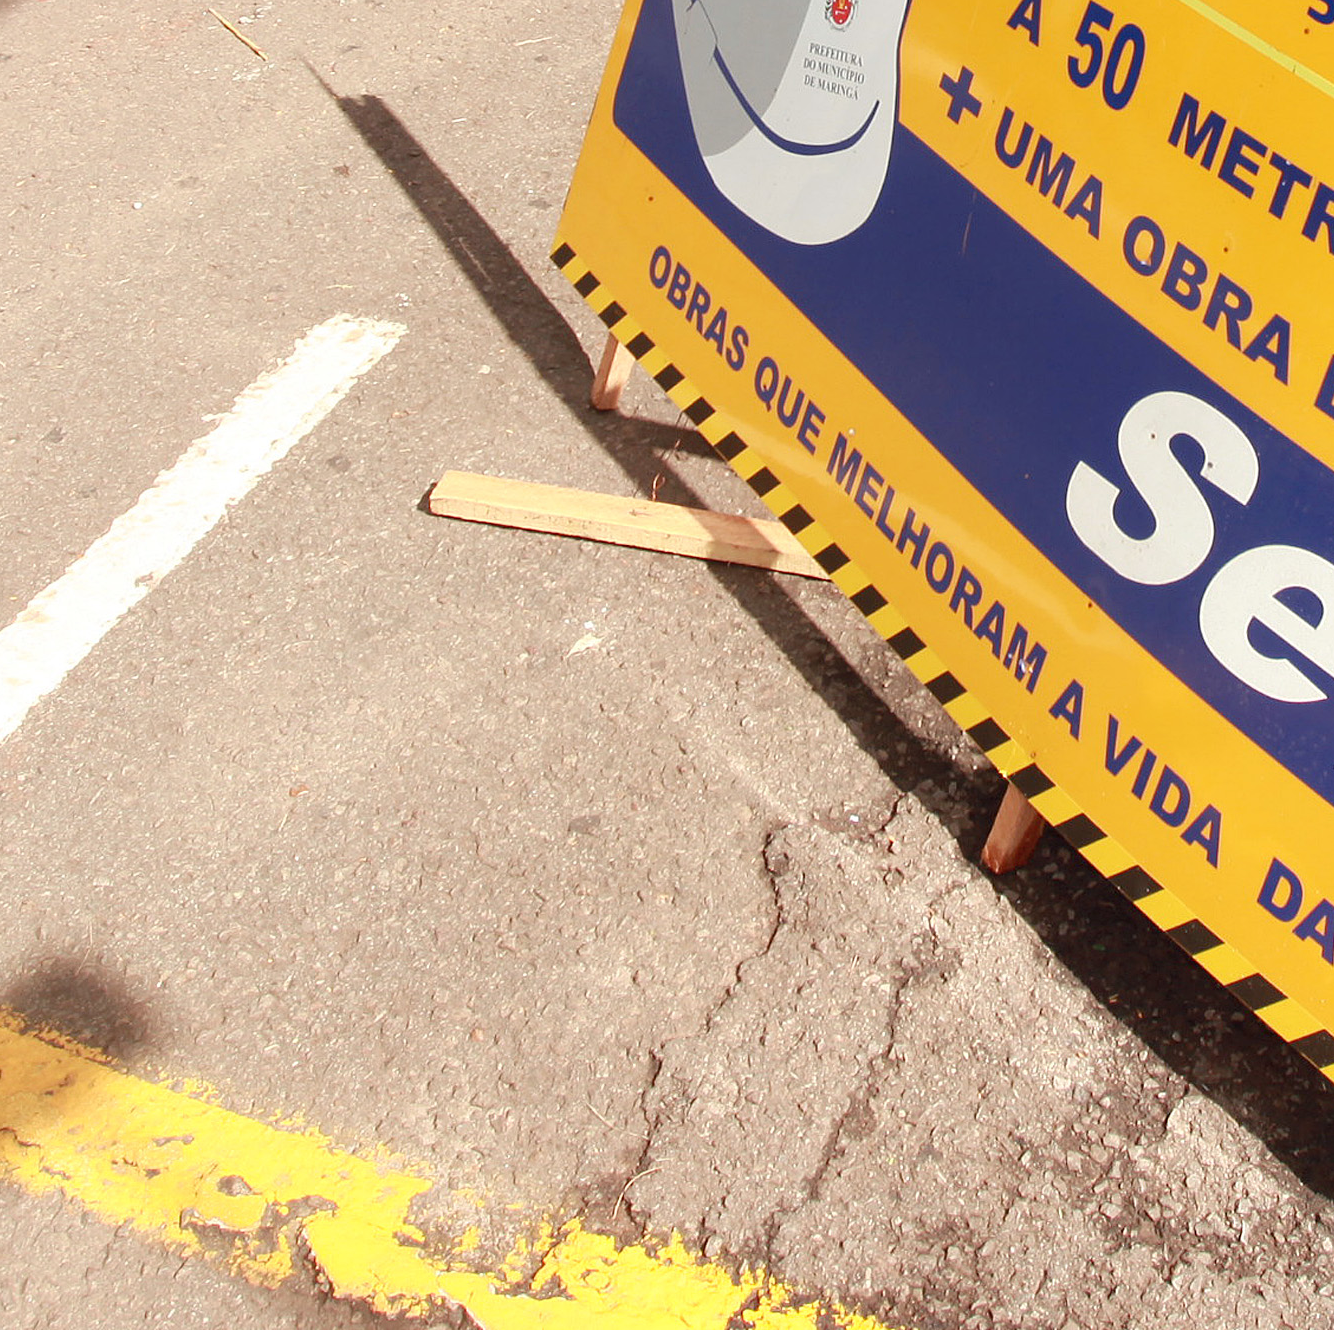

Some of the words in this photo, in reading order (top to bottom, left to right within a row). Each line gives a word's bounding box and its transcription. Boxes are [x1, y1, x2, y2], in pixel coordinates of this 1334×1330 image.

[803, 57, 816, 70] DO
[818, 63, 865, 85] MUNICÍPIO
[804, 74, 815, 87] DE
[818, 78, 859, 101] MARINGÁ
[809, 42, 863, 68] PREFEITURA
[1067, 0, 1147, 111] 50
[993, 106, 1103, 240] UMA
[1122, 214, 1293, 385] OBRA
[648, 244, 750, 373] OBRAS
[754, 355, 826, 452] QUE
[826, 431, 1048, 693] MELHORAM
[1049, 678, 1086, 742] A
[1103, 713, 1223, 870] VIDA
